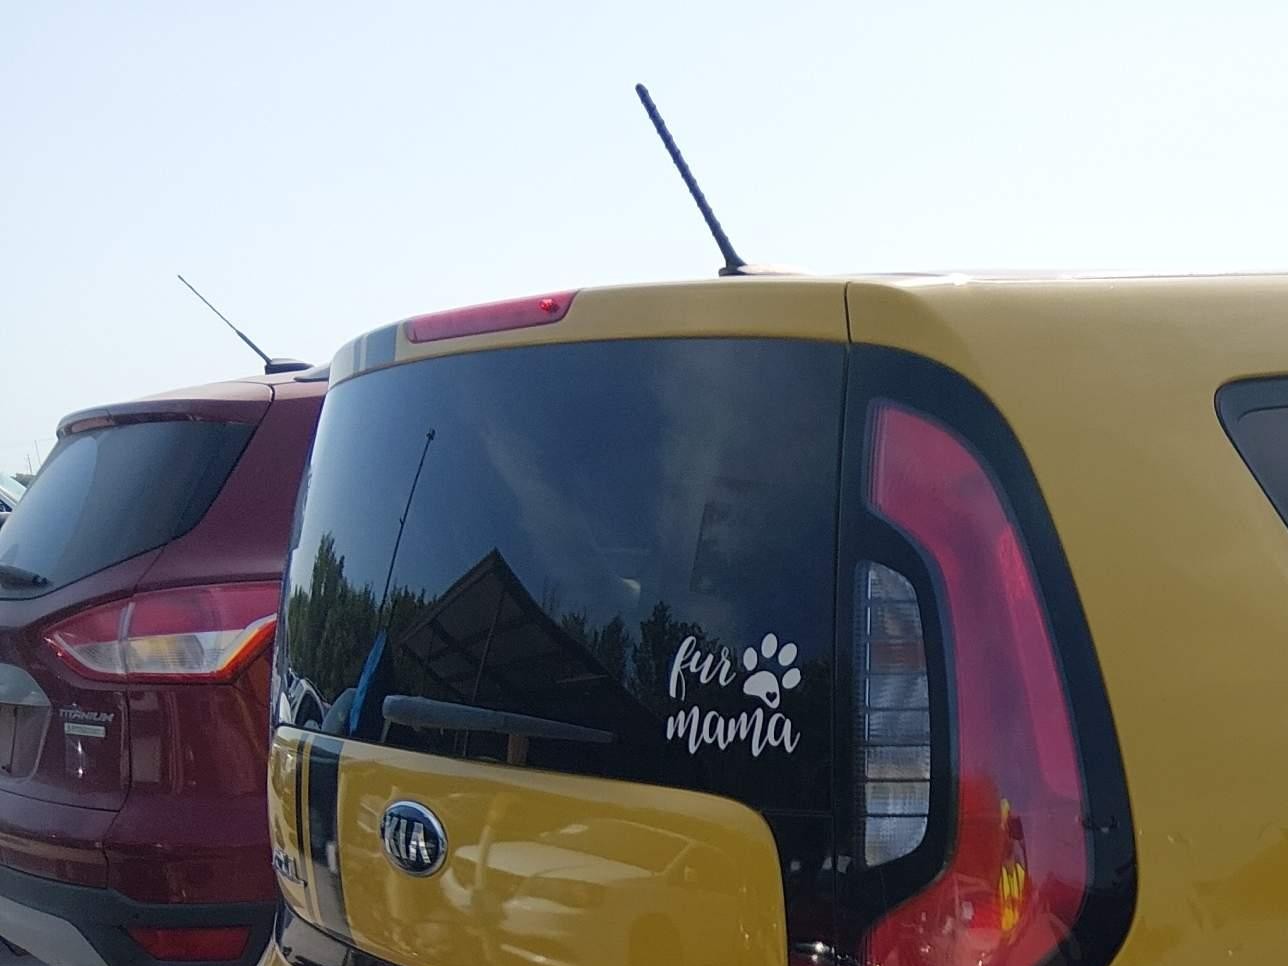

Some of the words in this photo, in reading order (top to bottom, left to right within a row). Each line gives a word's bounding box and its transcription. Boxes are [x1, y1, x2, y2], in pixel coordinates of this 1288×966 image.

[669, 635, 736, 701] fur
[59, 708, 115, 722] TITANIUM
[666, 705, 801, 757] mama
